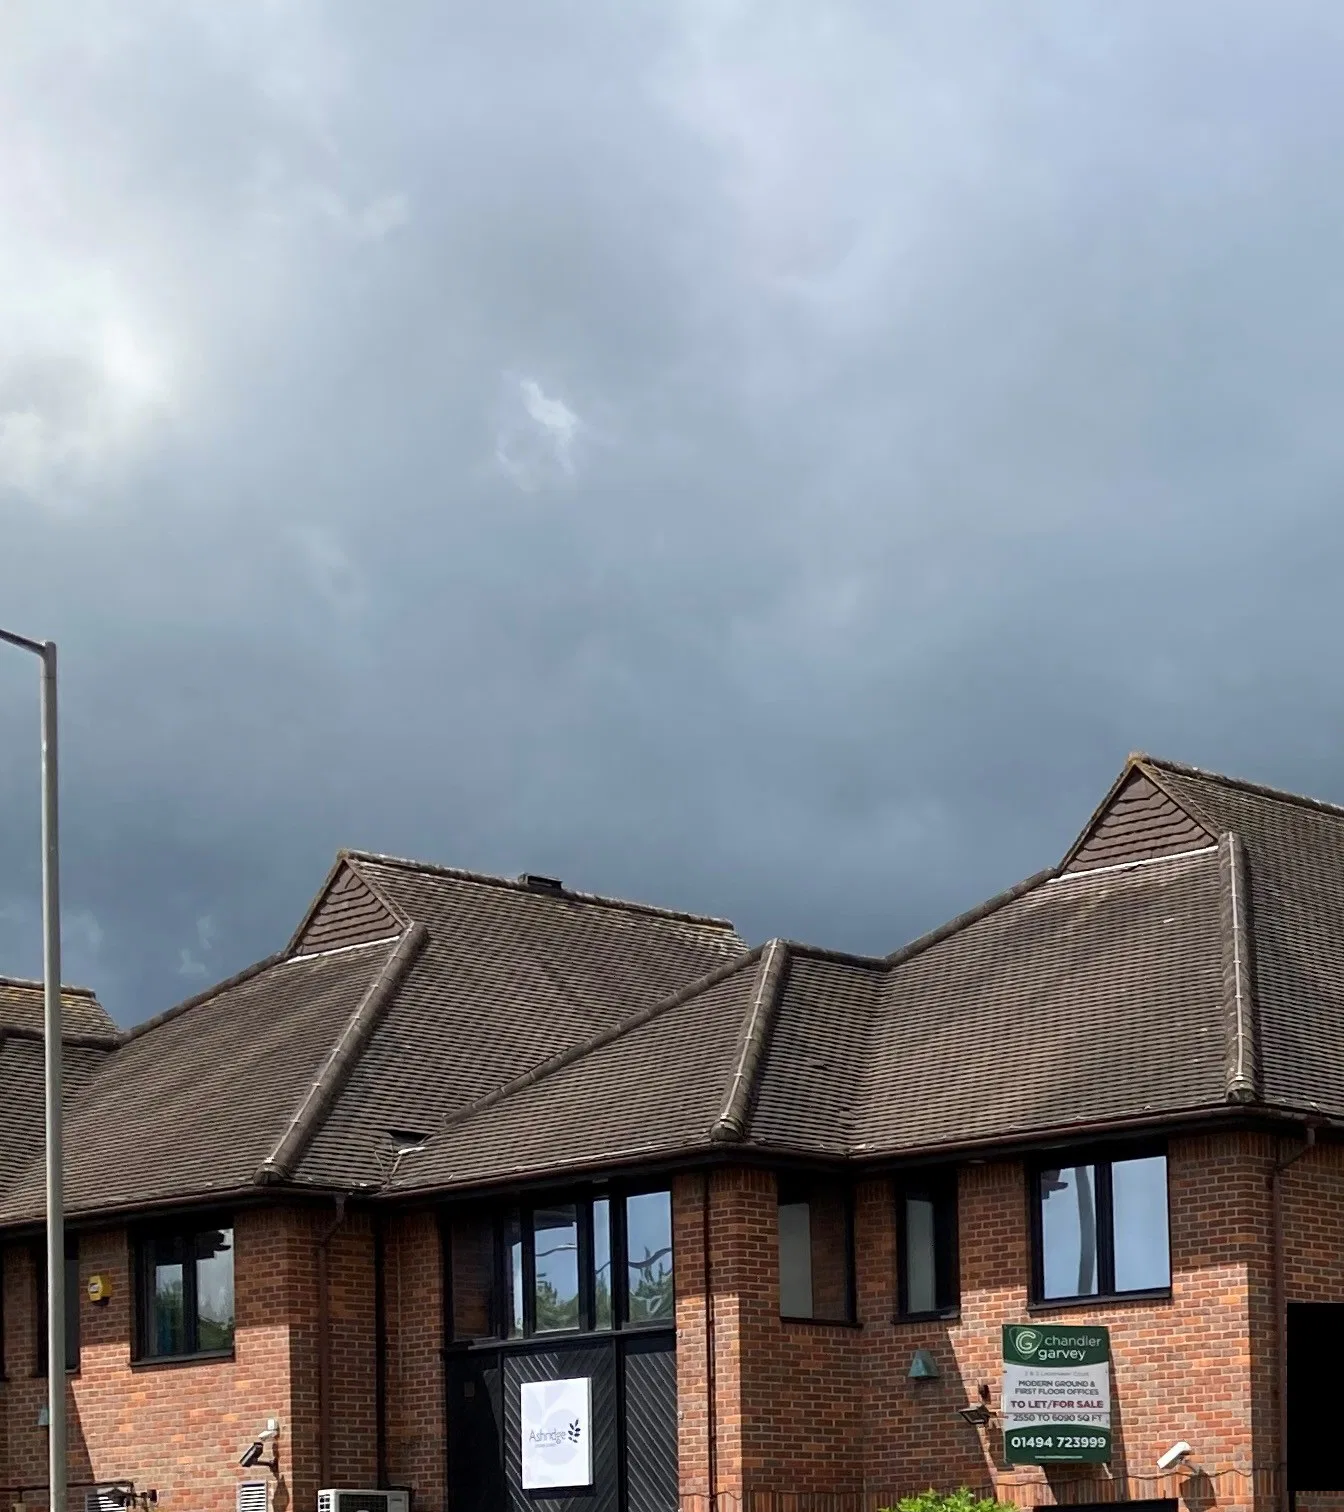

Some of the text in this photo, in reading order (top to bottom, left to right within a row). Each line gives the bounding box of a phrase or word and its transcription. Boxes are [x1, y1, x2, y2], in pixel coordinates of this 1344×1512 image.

[1044, 1335, 1102, 1346] chandler
[1038, 1349, 1086, 1361] garvey
[1011, 1436, 1106, 1448] 01494 723999
